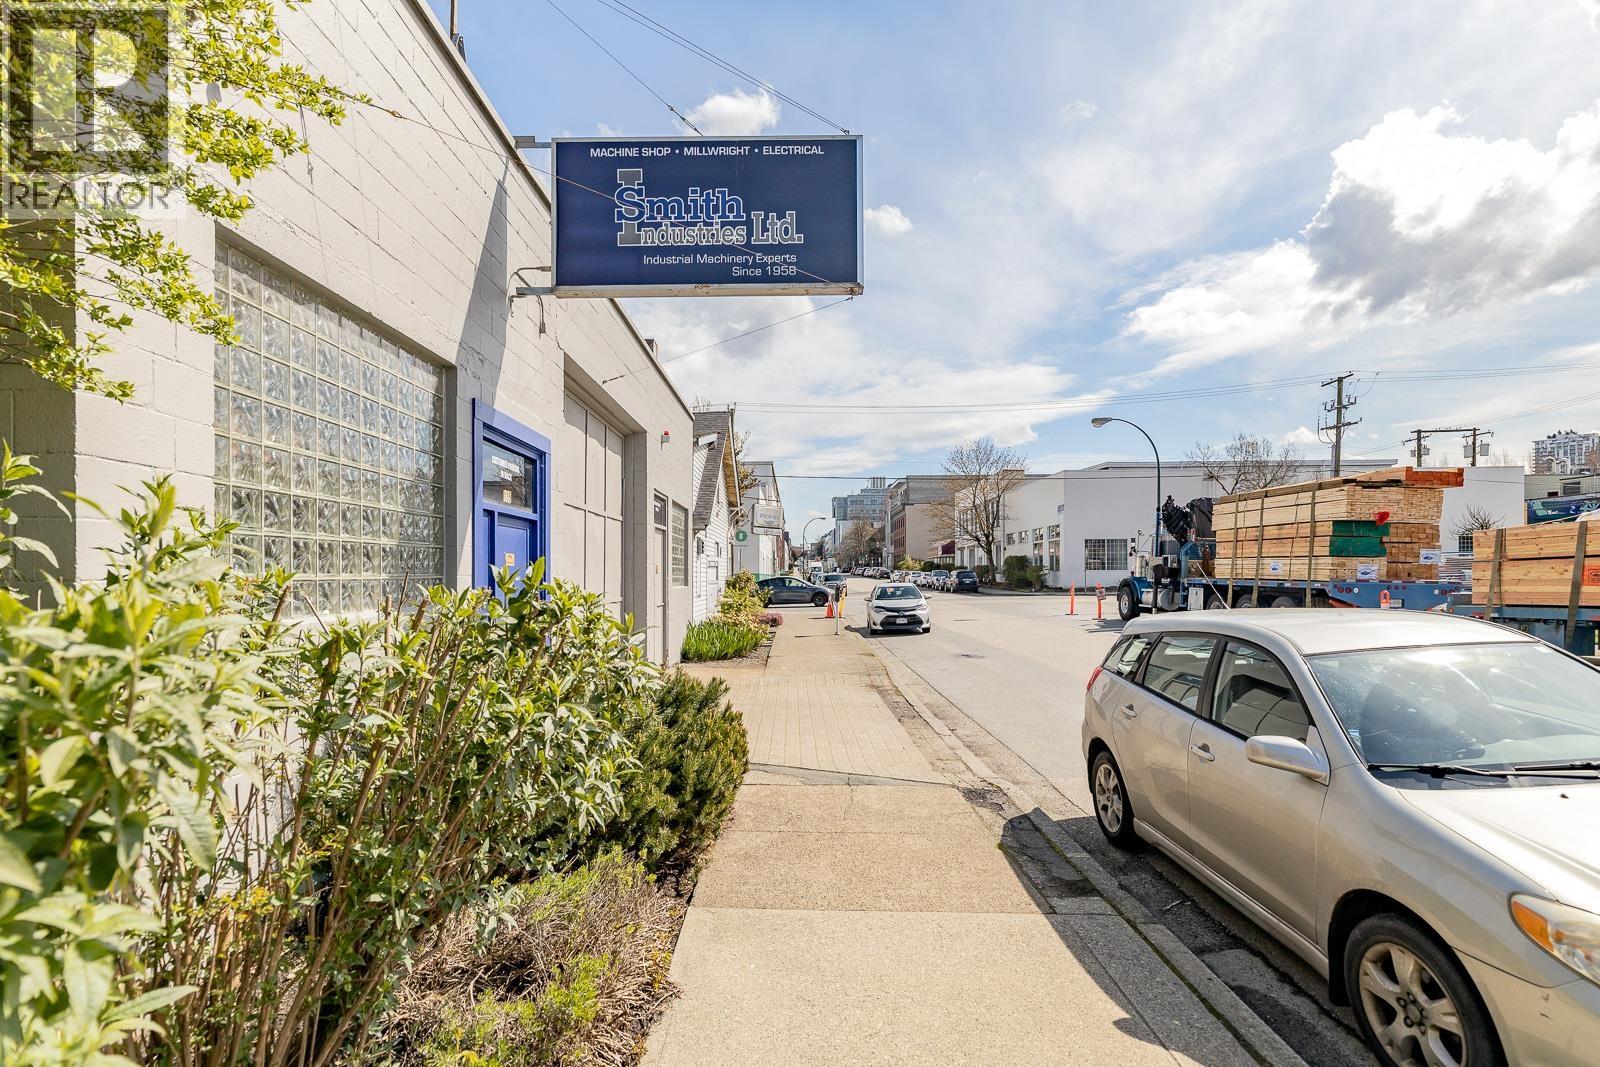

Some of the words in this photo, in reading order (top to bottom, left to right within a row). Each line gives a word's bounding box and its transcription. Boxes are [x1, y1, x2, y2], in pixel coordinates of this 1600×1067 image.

[590, 147, 639, 157] MACHINE
[641, 147, 671, 157] SHOP
[683, 146, 751, 156] MILLWRIGHT
[762, 145, 825, 156] ELECTRICAL
[614, 186, 746, 223] Smith
[751, 210, 804, 244] Ltd.
[643, 254, 694, 265] Industrial
[696, 253, 754, 265] Machinery
[756, 253, 797, 265] Experts
[732, 266, 762, 277] Since
[765, 265, 797, 276] 1958
